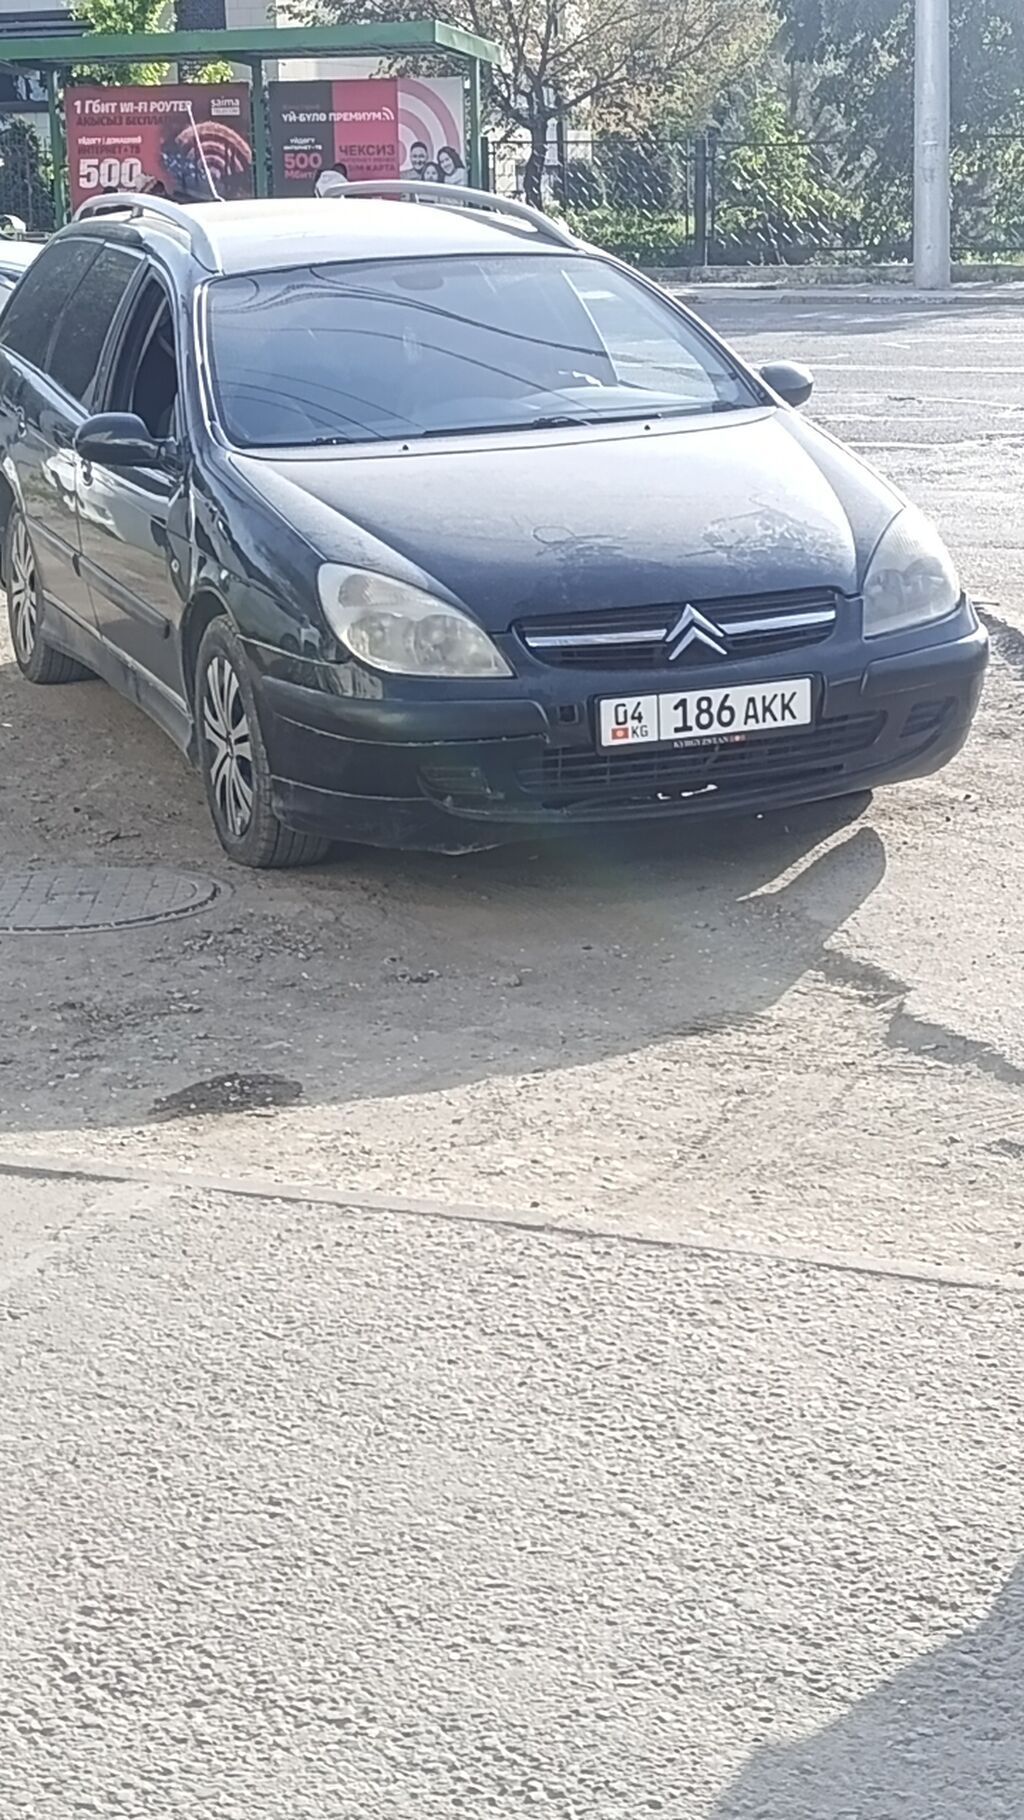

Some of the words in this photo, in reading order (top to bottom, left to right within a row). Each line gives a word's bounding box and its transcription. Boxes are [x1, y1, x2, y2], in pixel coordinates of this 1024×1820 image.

[74, 100, 81, 114] 1
[85, 99, 117, 114] Гбит
[120, 101, 147, 113] WI-FI
[150, 100, 192, 113] РОУТЕР
[211, 96, 240, 107] saima
[76, 115, 123, 126] АКЫСЫЗ
[328, 112, 381, 122] ПРЕМИУМ
[339, 144, 395, 156] ЧЕКСИЗ
[284, 153, 322, 169] 500
[79, 158, 142, 189] 500
[614, 702, 643, 726] 04
[672, 694, 735, 733] 186
[744, 692, 797, 726] AKK
[631, 725, 648, 738] KG
